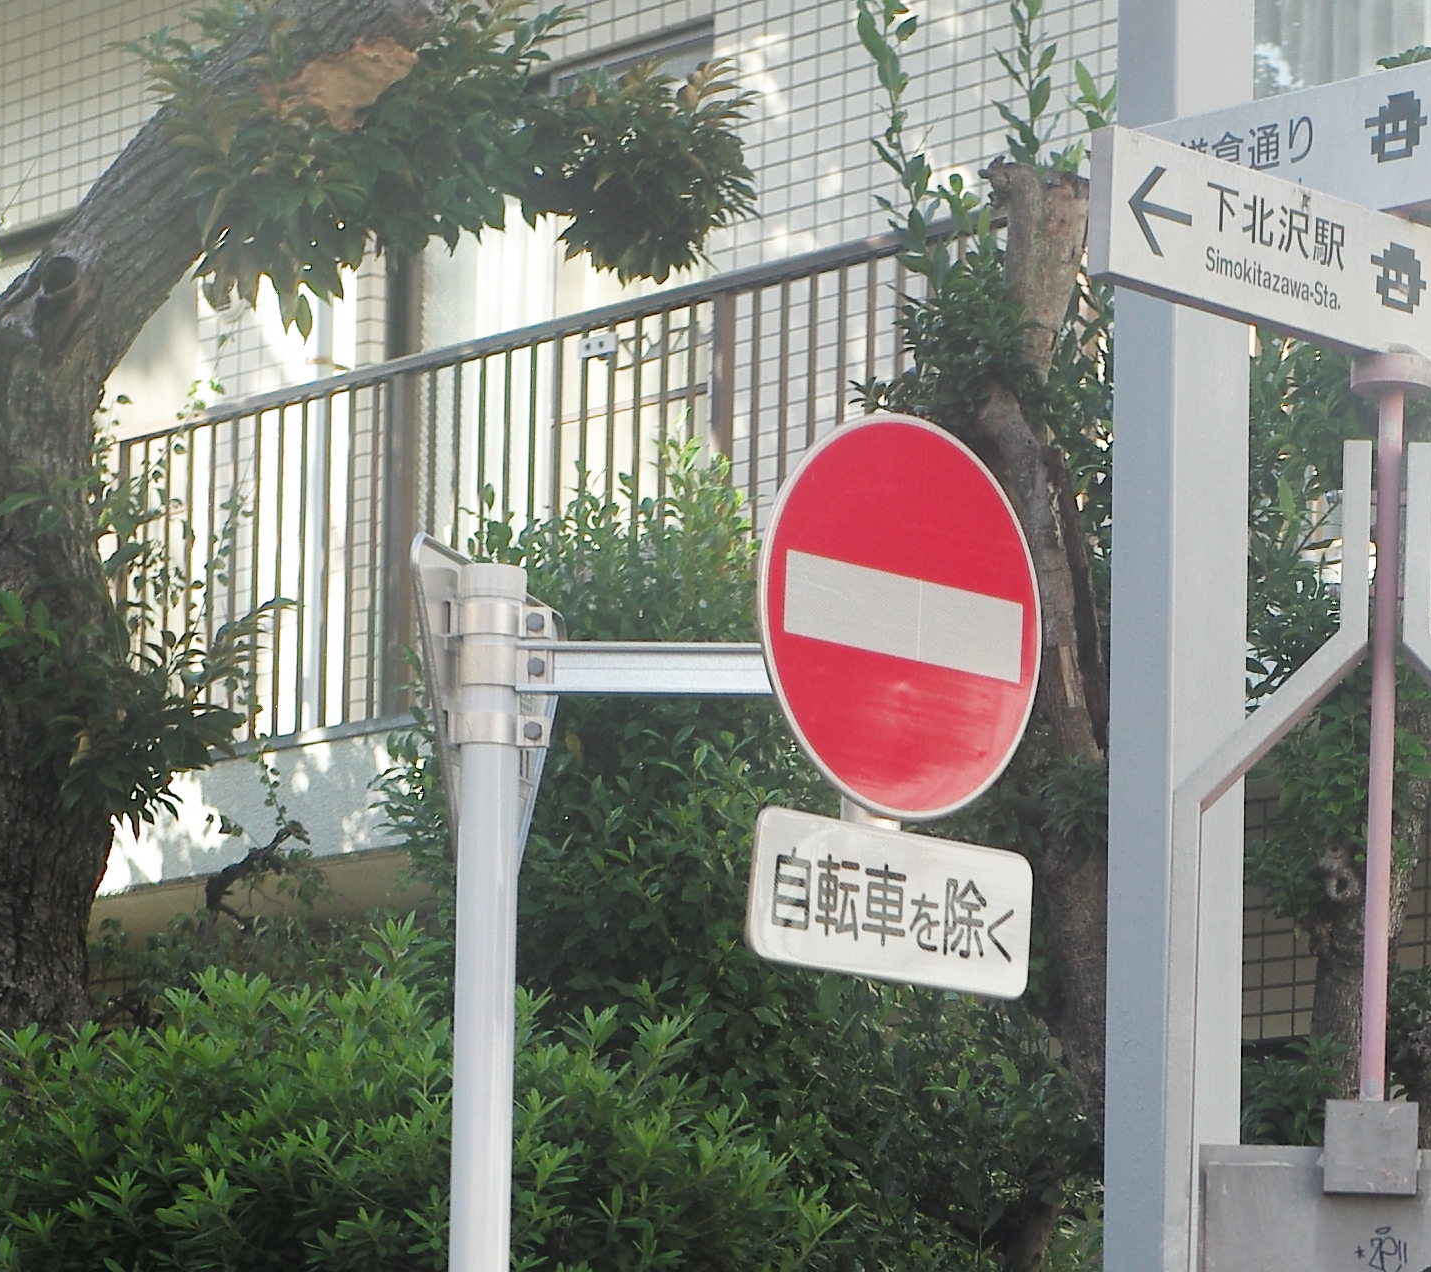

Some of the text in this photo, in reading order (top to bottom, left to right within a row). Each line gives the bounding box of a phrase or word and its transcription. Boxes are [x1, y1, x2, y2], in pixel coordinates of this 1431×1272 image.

[1206, 180, 1345, 272] 下北沢駅
[771, 846, 1015, 965] 自転車を除く
